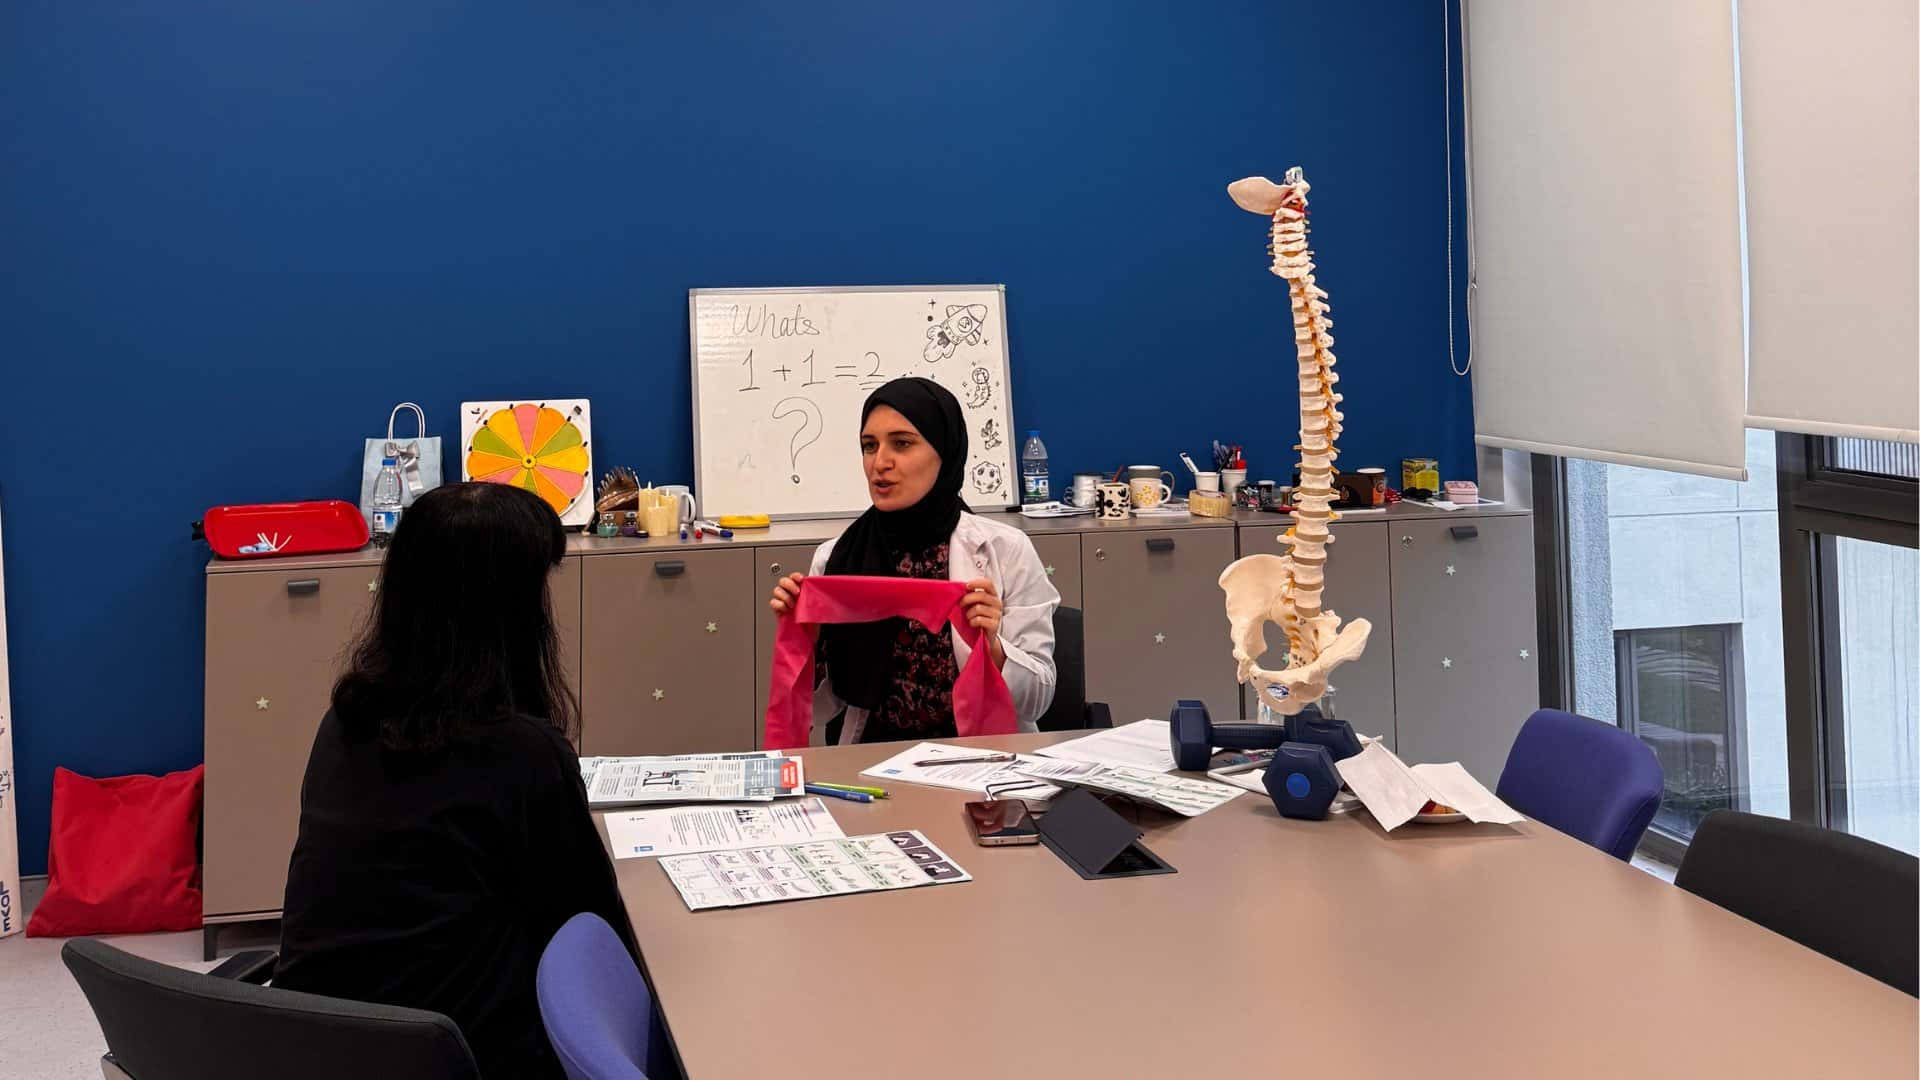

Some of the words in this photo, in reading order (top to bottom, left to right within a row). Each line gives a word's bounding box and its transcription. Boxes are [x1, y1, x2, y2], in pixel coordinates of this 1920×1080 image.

[732, 303, 820, 339] Whats
[738, 348, 761, 391] 1
[800, 348, 827, 387] 1
